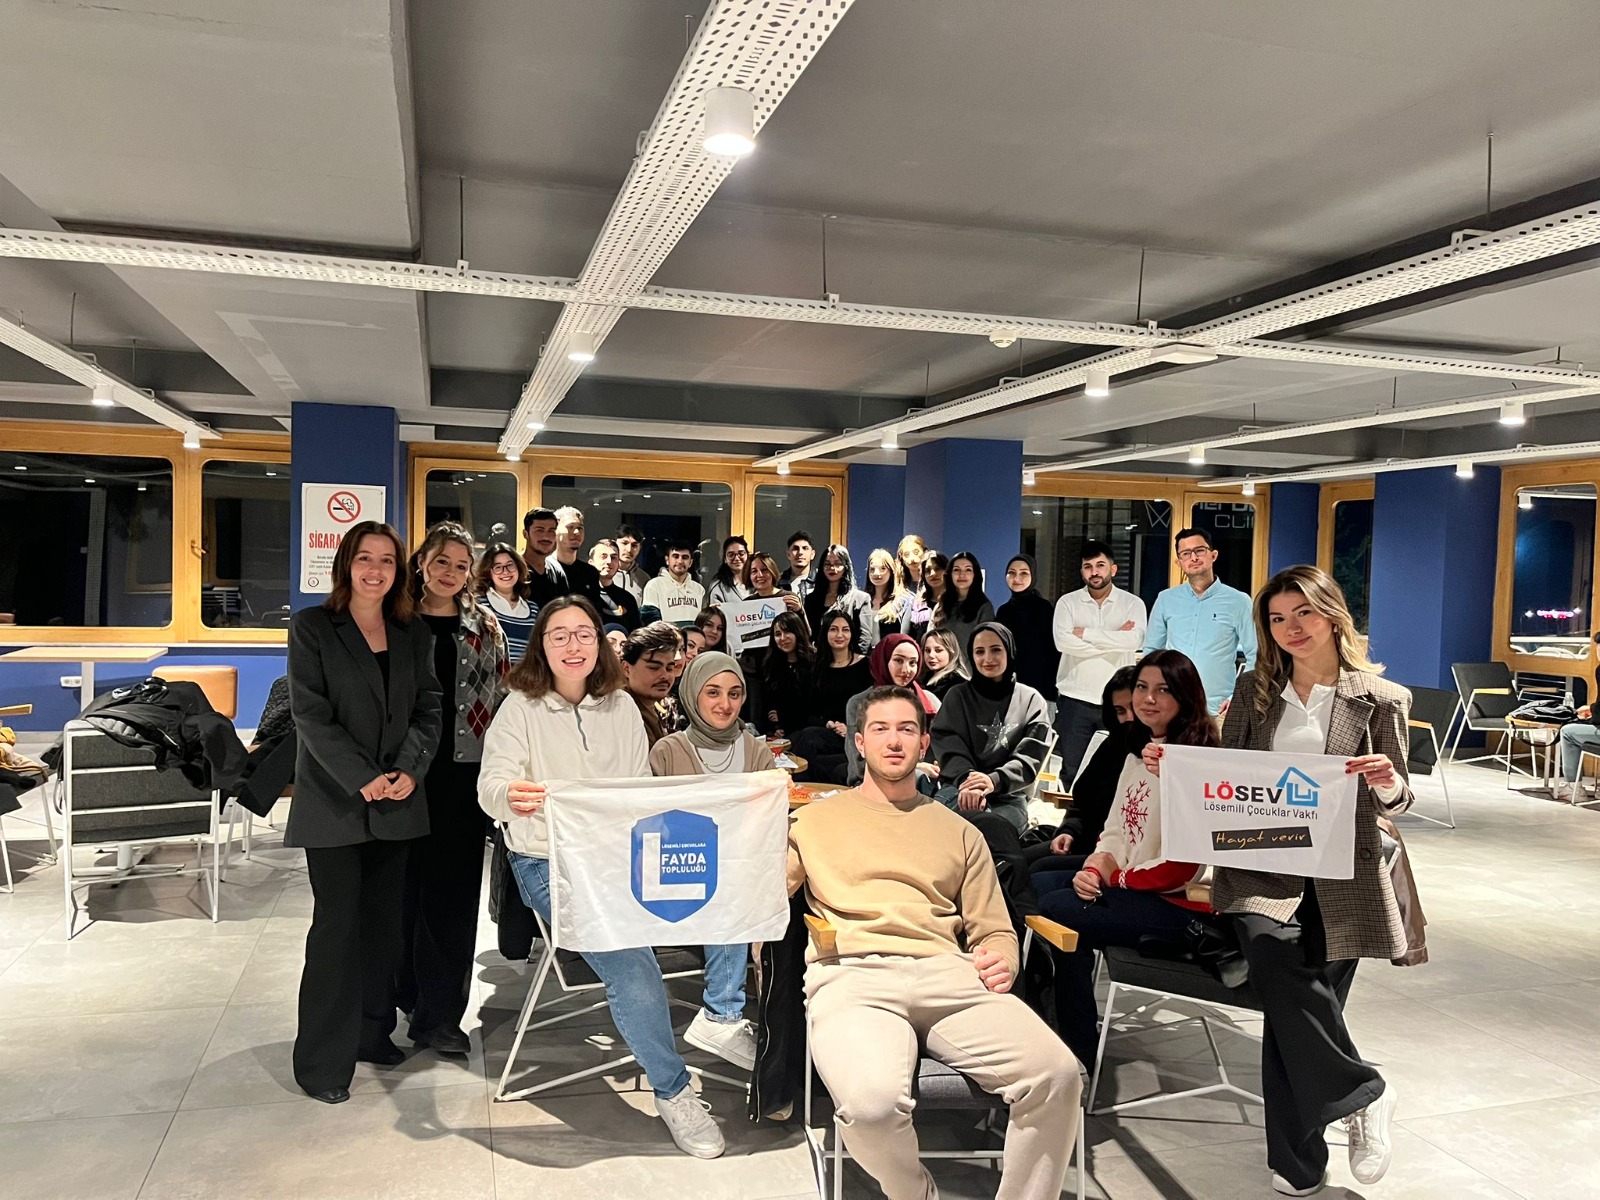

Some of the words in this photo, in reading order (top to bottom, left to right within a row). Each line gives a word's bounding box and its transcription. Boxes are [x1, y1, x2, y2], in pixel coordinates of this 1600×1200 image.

[1204, 781, 1283, 804] LÖSEV
[1204, 801, 1245, 814] Lösemili
[1247, 805, 1291, 818] Çocuklar
[1293, 808, 1318, 820] Vakfı
[1216, 831, 1264, 848] Hayat
[1271, 833, 1306, 842] verir
[661, 852, 706, 866] FAYDA
[661, 864, 706, 873] TOPLULUĞU
